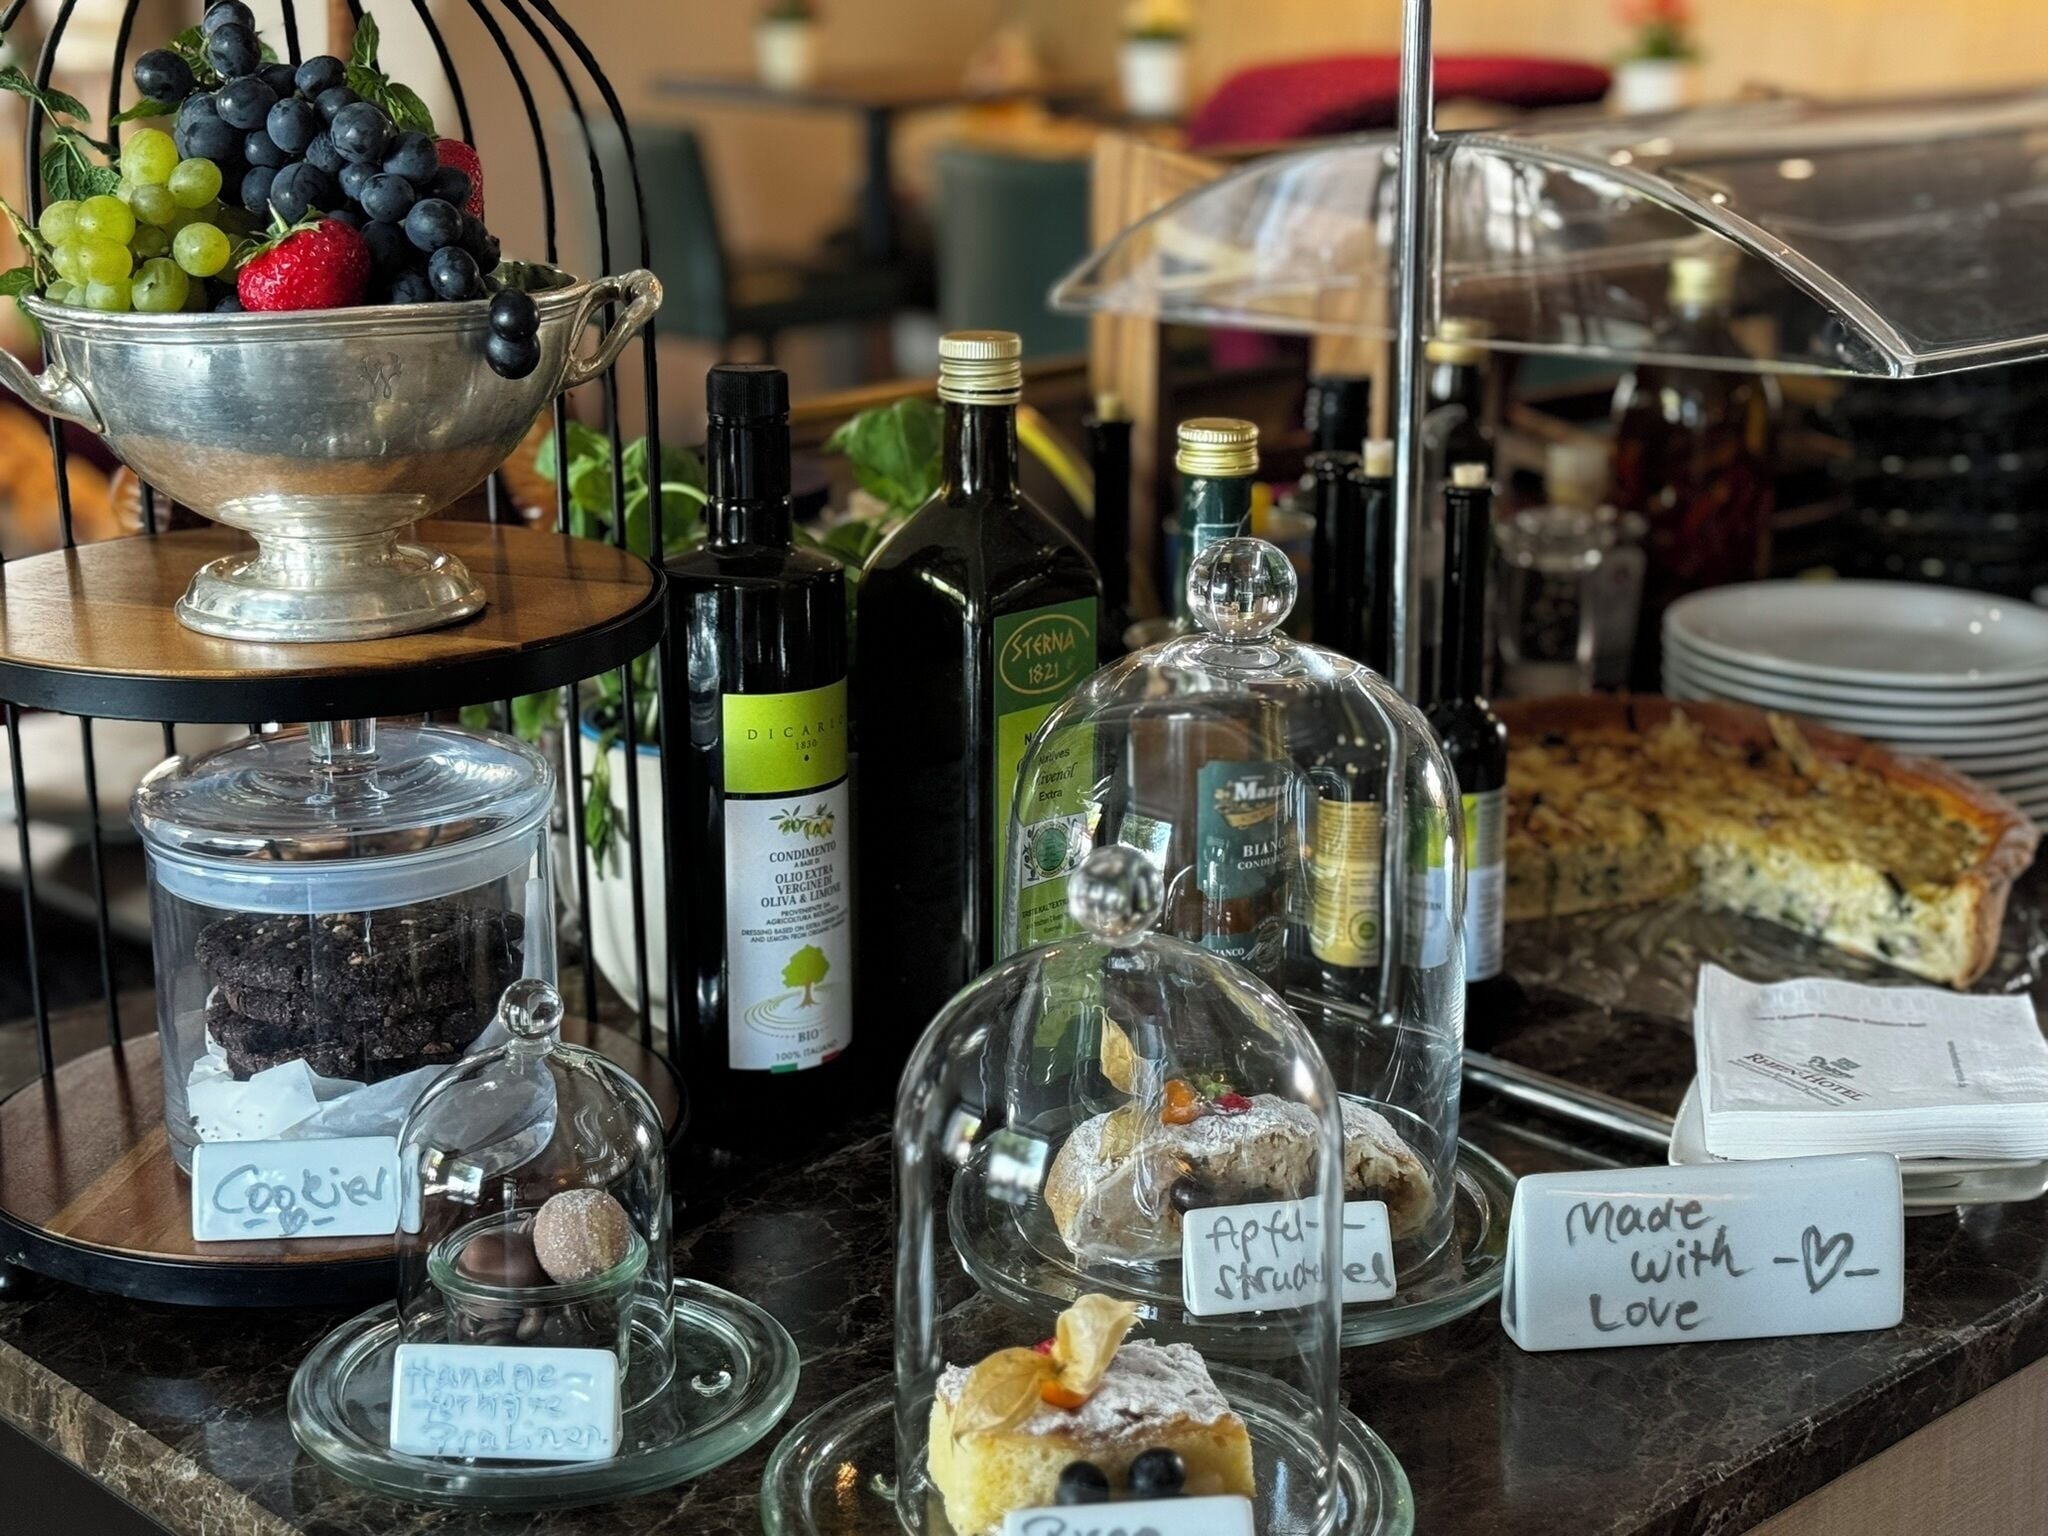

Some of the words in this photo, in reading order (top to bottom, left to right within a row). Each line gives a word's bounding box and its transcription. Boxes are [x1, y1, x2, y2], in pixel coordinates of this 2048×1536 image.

[1011, 628, 1076, 662] STERNA
[1029, 662, 1059, 685] 1821
[1039, 788, 1063, 802] Extra
[769, 840, 836, 863] CONDIMENTO
[775, 871, 803, 885] OLIO
[805, 863, 834, 881] EXTRA
[777, 877, 823, 895] VERGINE
[761, 895, 797, 908] OLIVA
[800, 893, 807, 904] &
[798, 1028, 820, 1043] BIO
[776, 1050, 801, 1062] 100%
[1566, 1197, 1714, 1247] Made
[1631, 1225, 1756, 1284] with
[1589, 1293, 1712, 1332] Love
